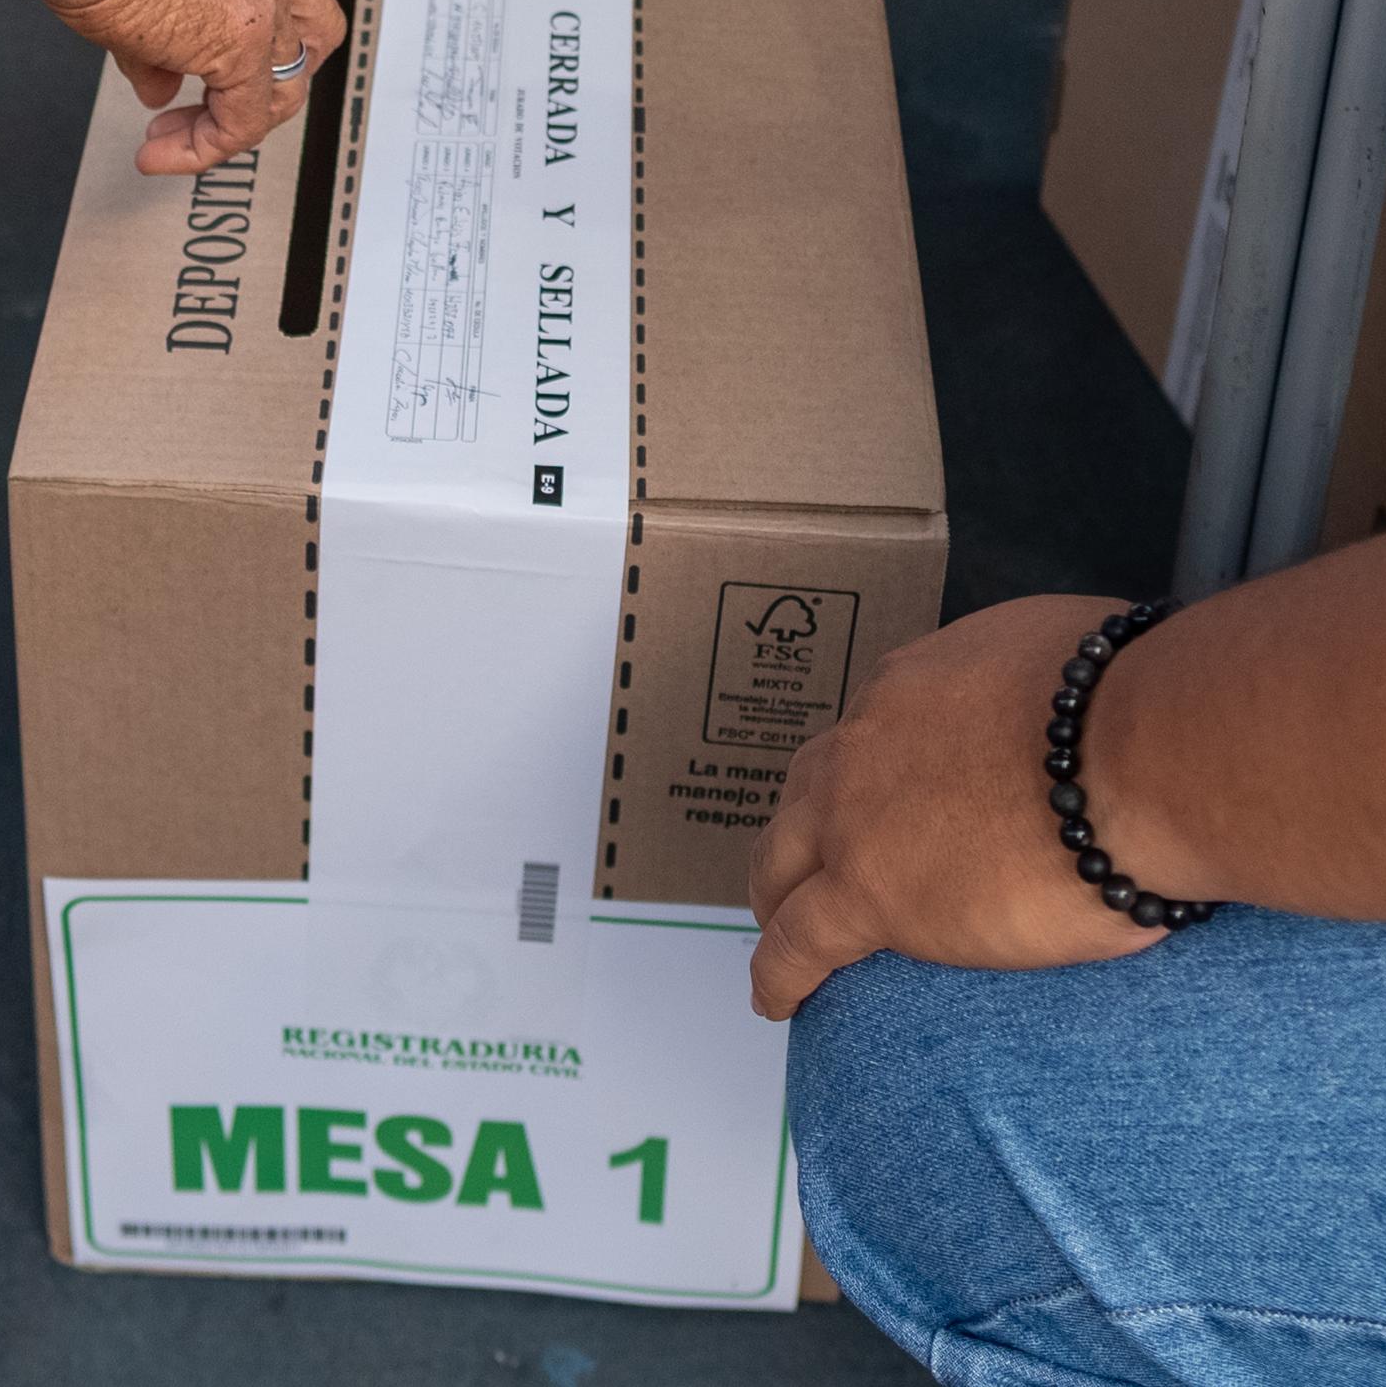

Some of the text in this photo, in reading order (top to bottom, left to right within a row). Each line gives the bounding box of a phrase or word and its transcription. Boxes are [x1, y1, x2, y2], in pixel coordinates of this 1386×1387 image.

[545, 10, 581, 167] CERRADA
[543, 203, 575, 228] Y
[533, 263, 575, 445] SELLADA
[540, 473, 556, 496] E-9
[753, 643, 814, 662] FSC
[751, 678, 804, 692] MIXTO
[688, 759, 788, 785] La marc
[669, 783, 761, 807] manejo
[685, 809, 773, 829] respon
[282, 1046, 581, 1080] NACIONAL DEL ESTADO CIVIL
[169, 1104, 670, 1226] MESA 1
